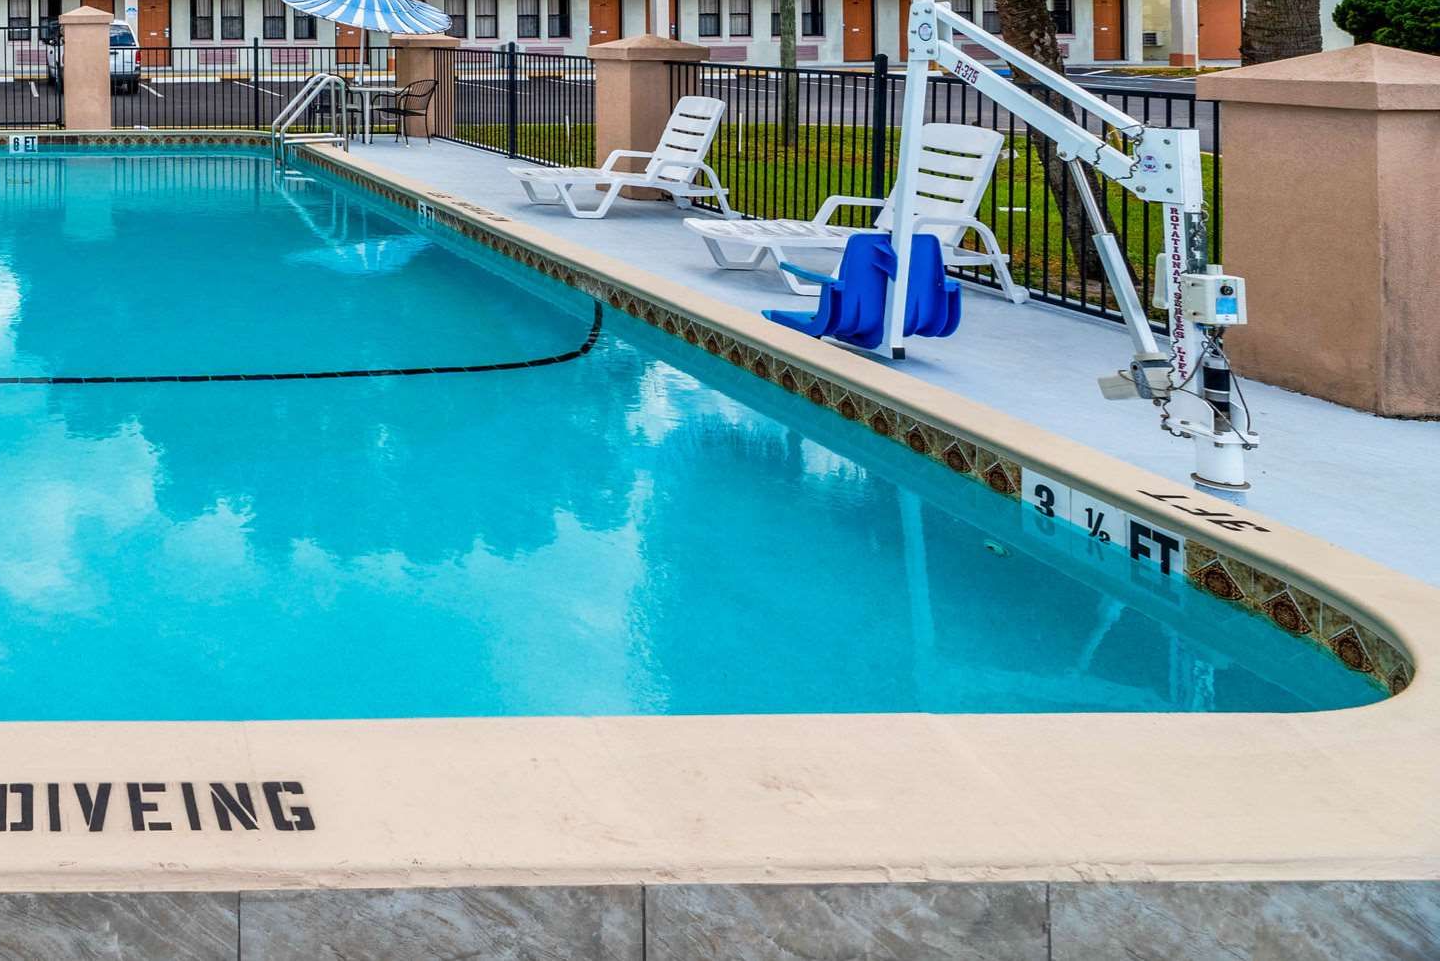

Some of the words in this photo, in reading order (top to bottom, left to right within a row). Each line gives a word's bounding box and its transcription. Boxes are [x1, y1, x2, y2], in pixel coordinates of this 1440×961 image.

[954, 60, 980, 84] R-375
[1170, 208, 1181, 284] ROTATIONAL
[1174, 292, 1184, 338] SERIES
[1176, 346, 1188, 380] LIFT
[1034, 484, 1055, 518] 3
[1130, 520, 1180, 575] FT
